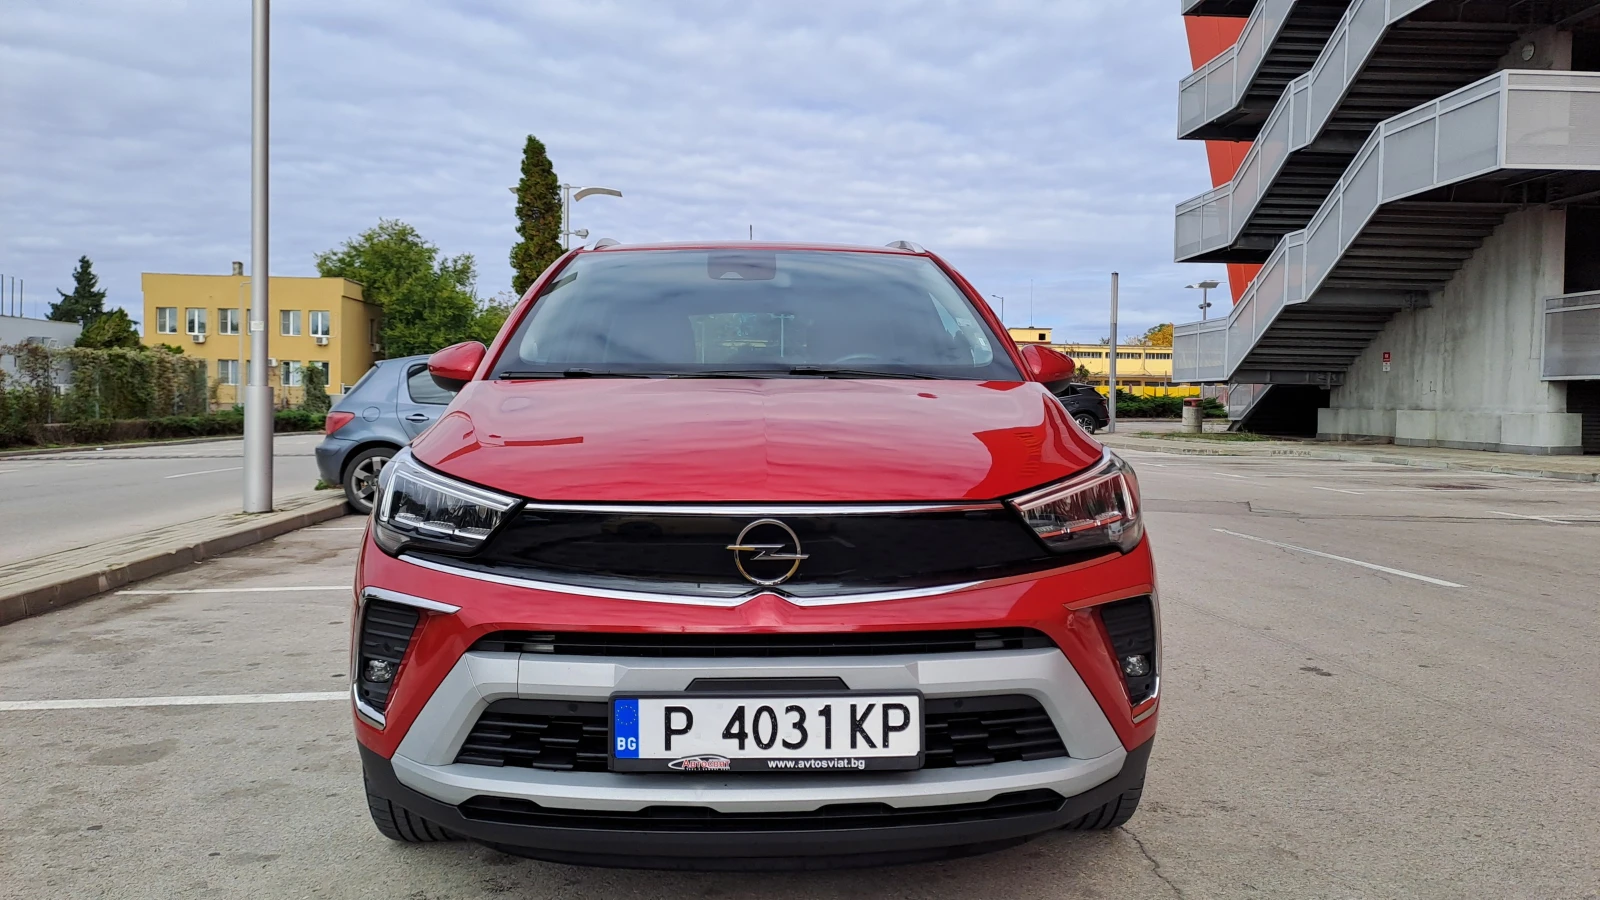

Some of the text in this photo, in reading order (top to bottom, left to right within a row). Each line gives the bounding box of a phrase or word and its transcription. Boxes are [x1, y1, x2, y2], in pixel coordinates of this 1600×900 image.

[664, 703, 911, 751] P 4031 KP
[617, 737, 637, 751] BG
[767, 759, 866, 770] www.avtosviat.bg
